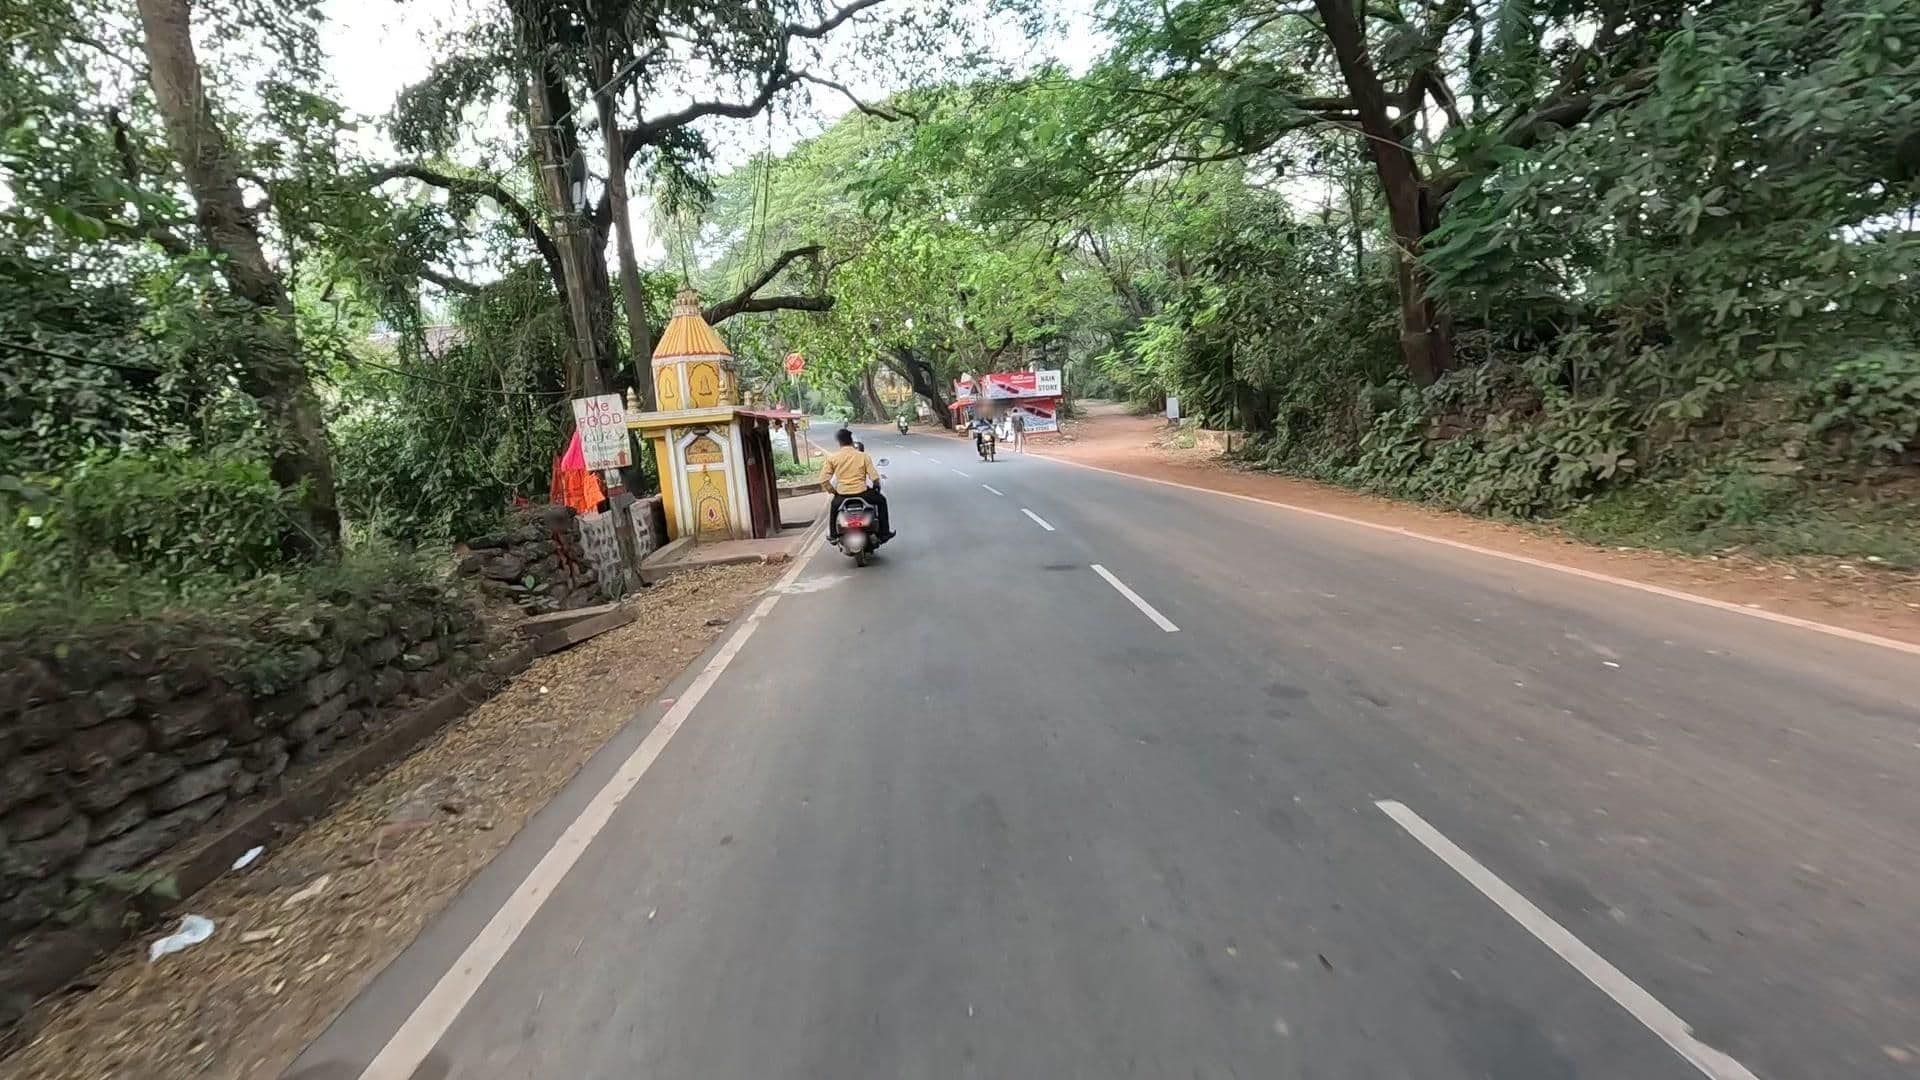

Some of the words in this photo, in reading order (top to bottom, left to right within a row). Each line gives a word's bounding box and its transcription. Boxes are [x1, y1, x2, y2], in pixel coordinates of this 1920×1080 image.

[1038, 384, 1058, 392] STORE
[586, 399, 609, 415] Me
[578, 413, 622, 428] FOOD
